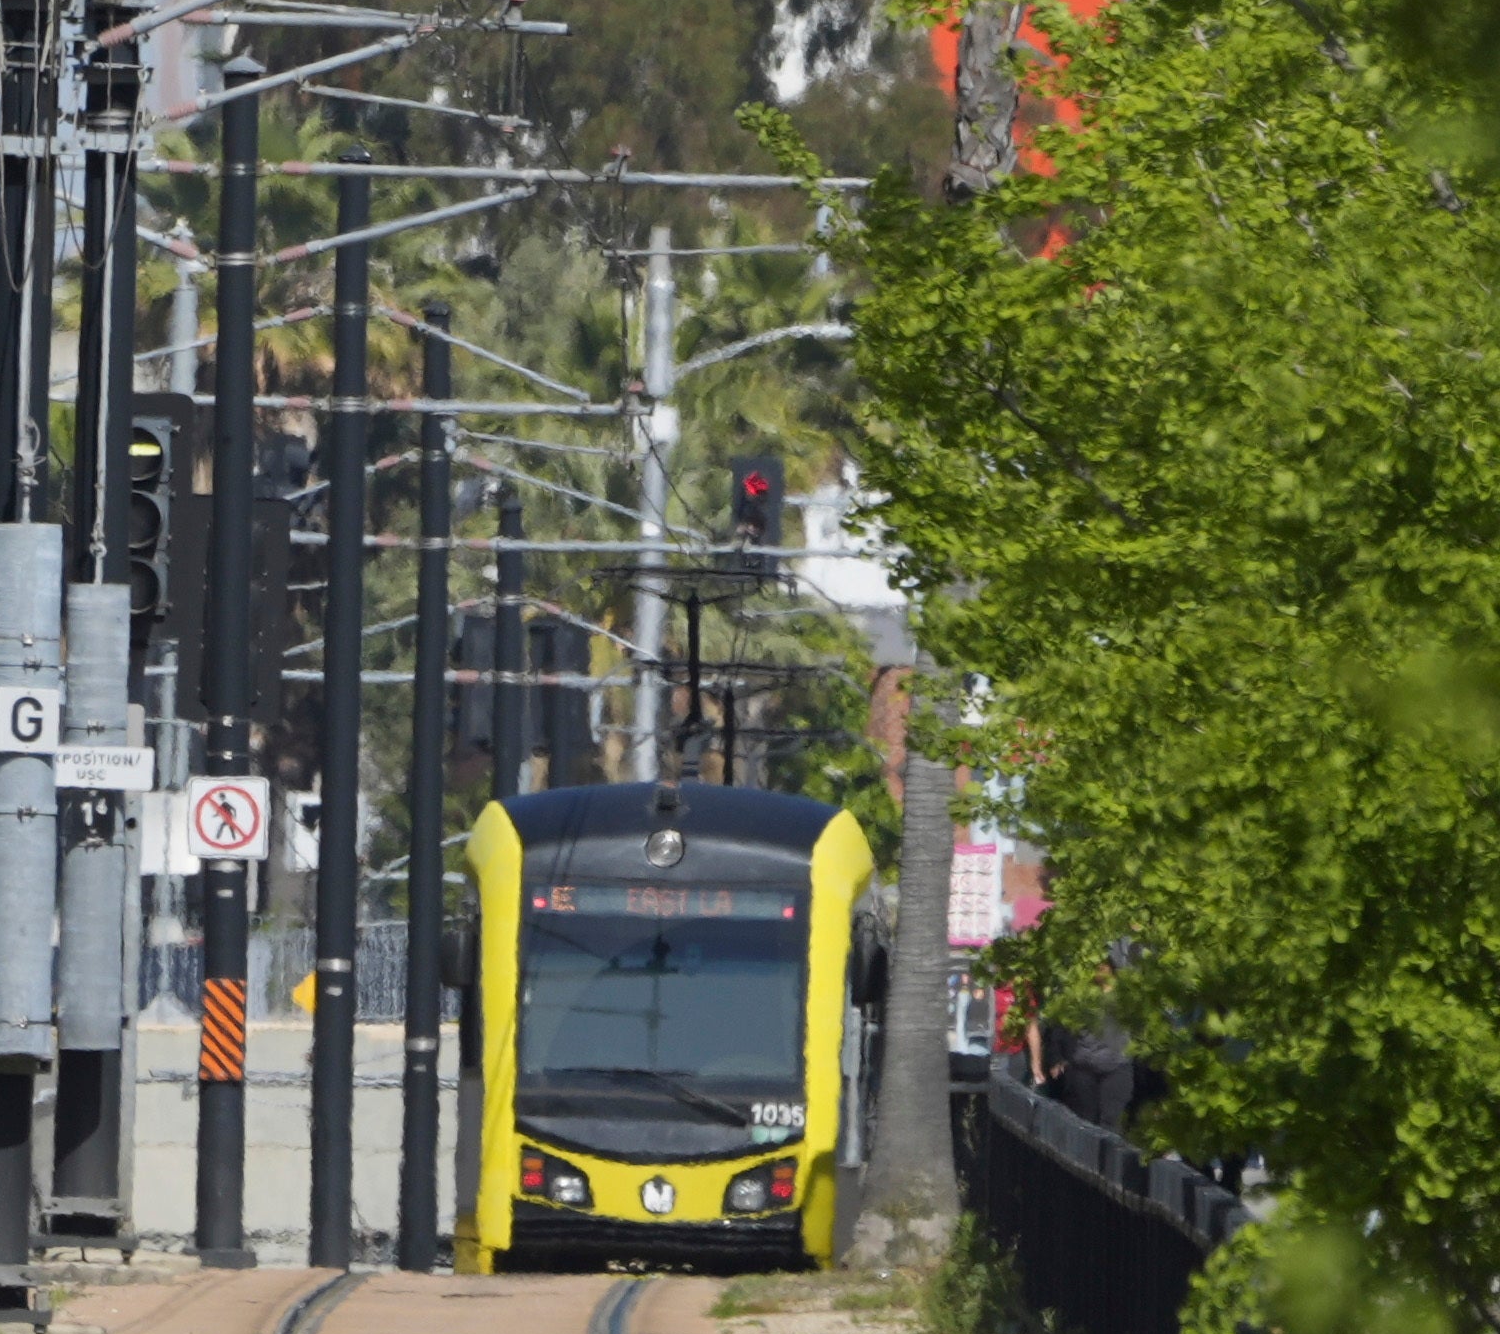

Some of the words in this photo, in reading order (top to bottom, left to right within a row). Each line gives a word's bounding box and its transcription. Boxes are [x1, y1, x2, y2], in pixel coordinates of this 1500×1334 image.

[11, 696, 44, 743] G
[76, 769, 107, 782] USC
[626, 886, 688, 917] EAST
[750, 1101, 806, 1127] 1035
